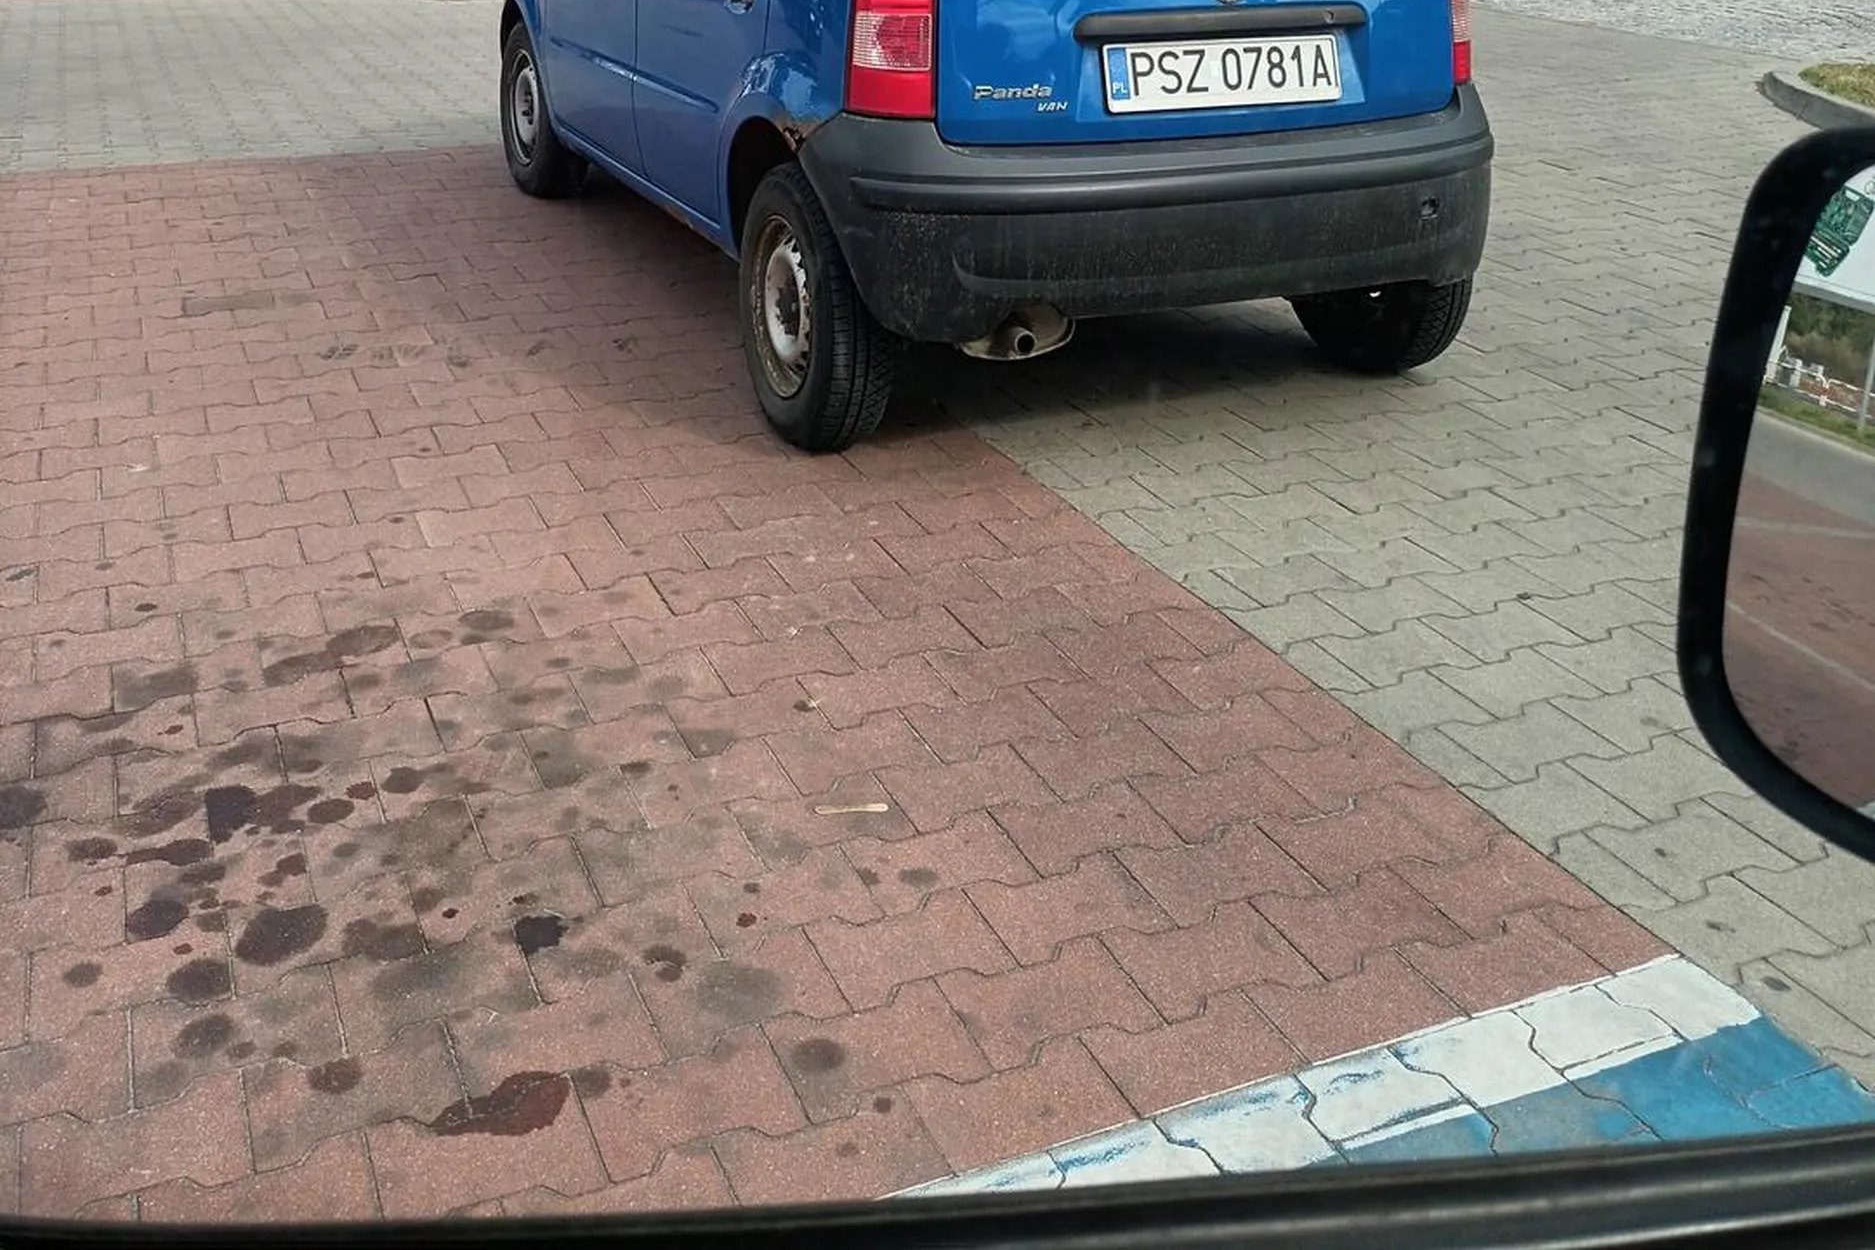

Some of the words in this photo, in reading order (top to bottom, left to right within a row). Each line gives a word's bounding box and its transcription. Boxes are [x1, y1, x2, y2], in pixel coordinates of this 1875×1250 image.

[1130, 49, 1209, 97] PSZ
[1220, 44, 1332, 92] 0781A
[974, 83, 1053, 100] Panda
[1112, 81, 1128, 94] PL
[1037, 101, 1068, 112] VAN
